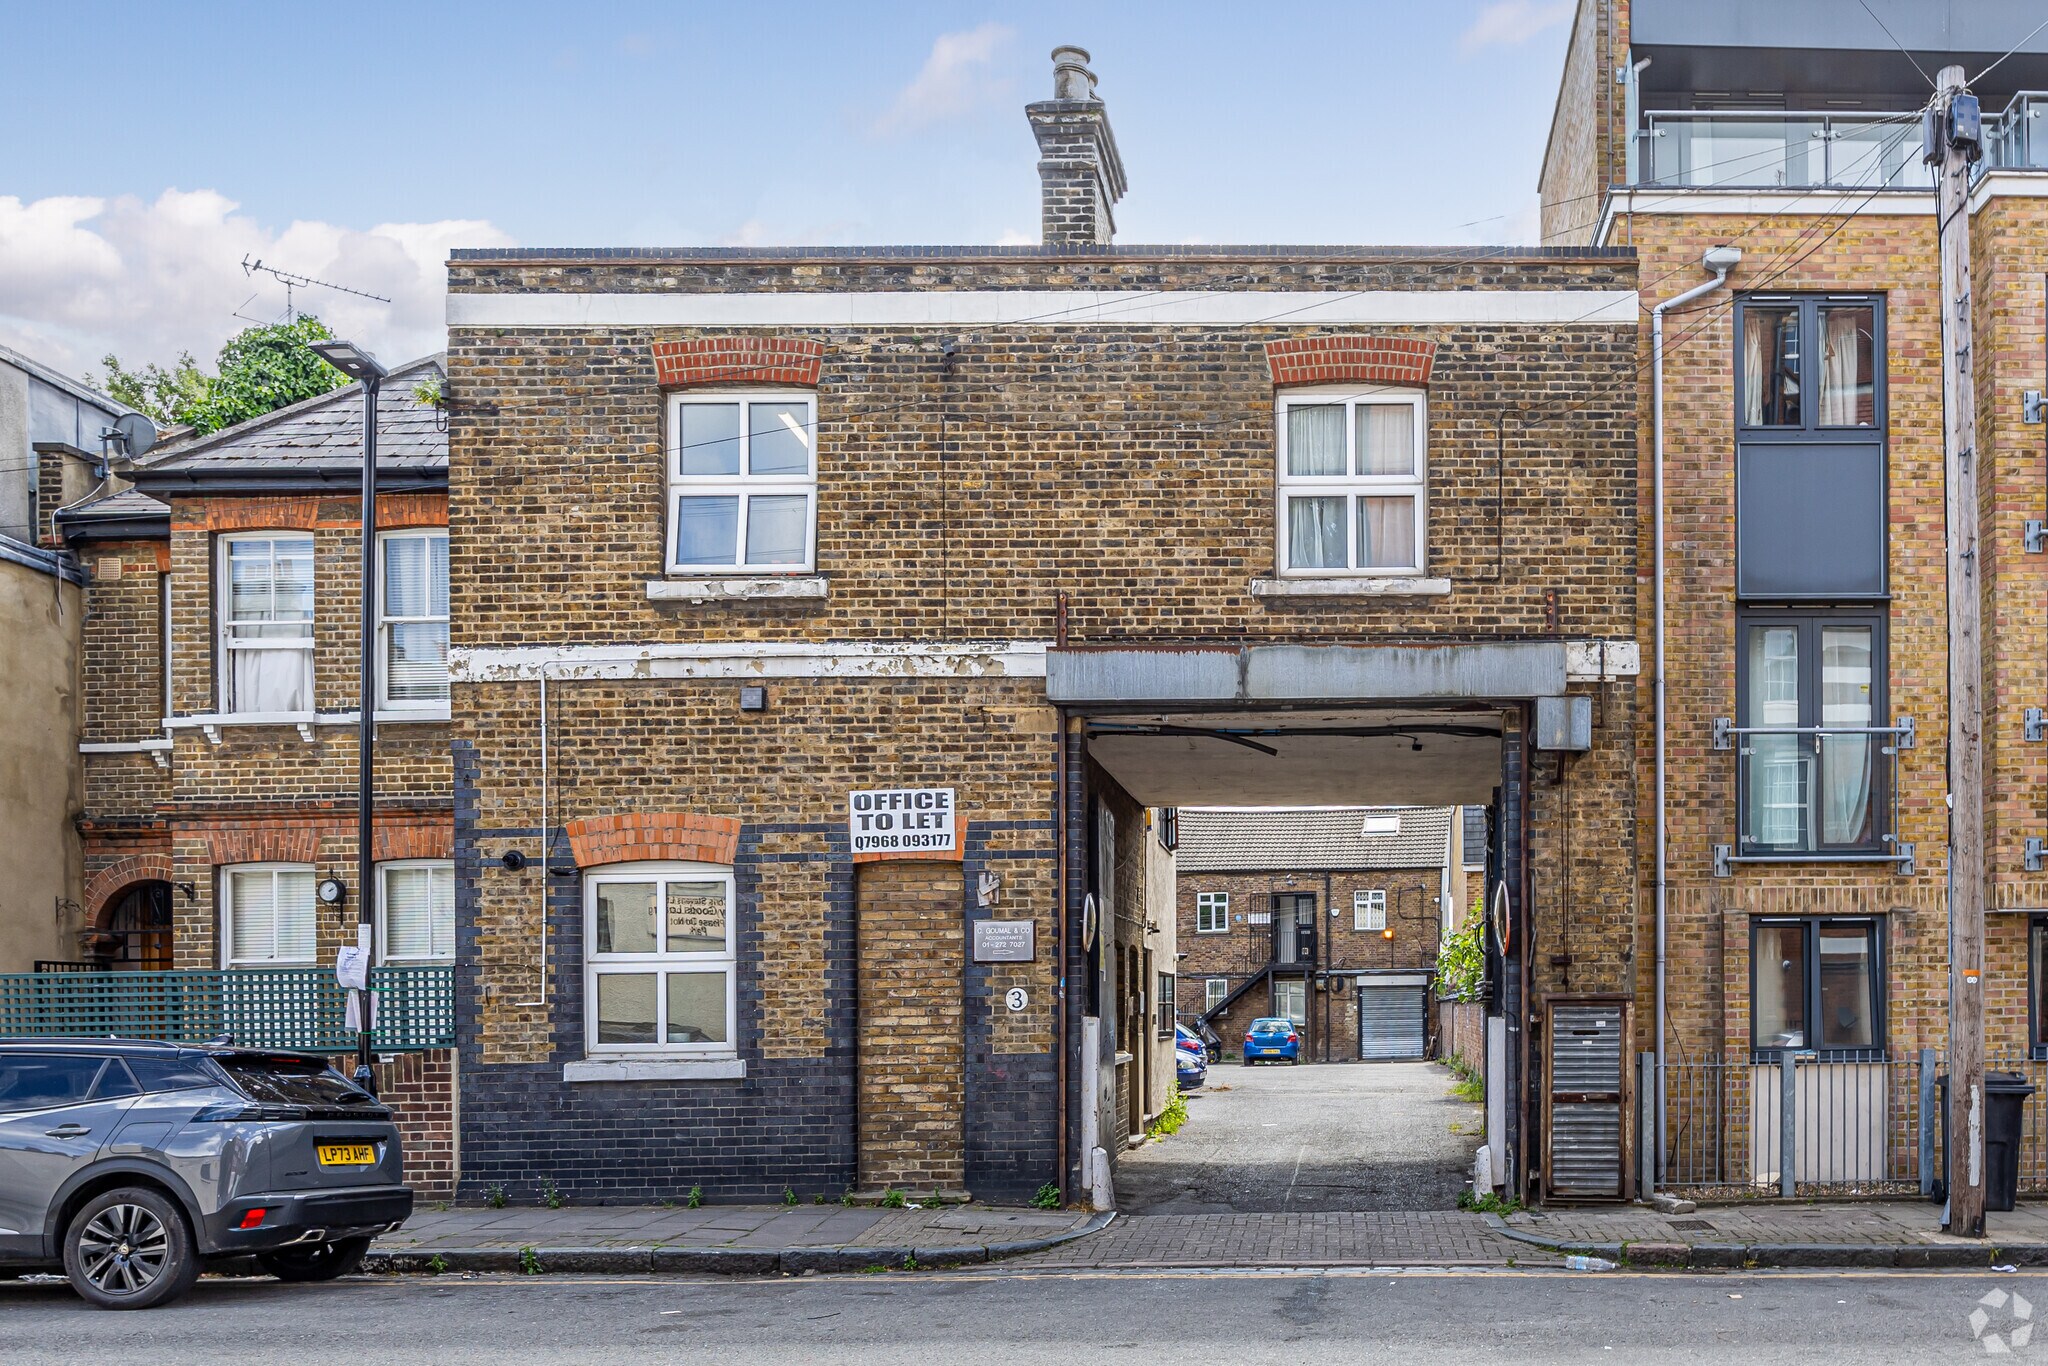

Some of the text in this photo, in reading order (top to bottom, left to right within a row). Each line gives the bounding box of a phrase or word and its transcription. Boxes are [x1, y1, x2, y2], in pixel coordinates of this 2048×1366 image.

[853, 792, 949, 811] OFFICE
[856, 812, 948, 831] TO LET
[902, 834, 951, 848] 093177
[1011, 990, 1022, 1009] 3
[322, 1147, 369, 1162] LP73 AHF
